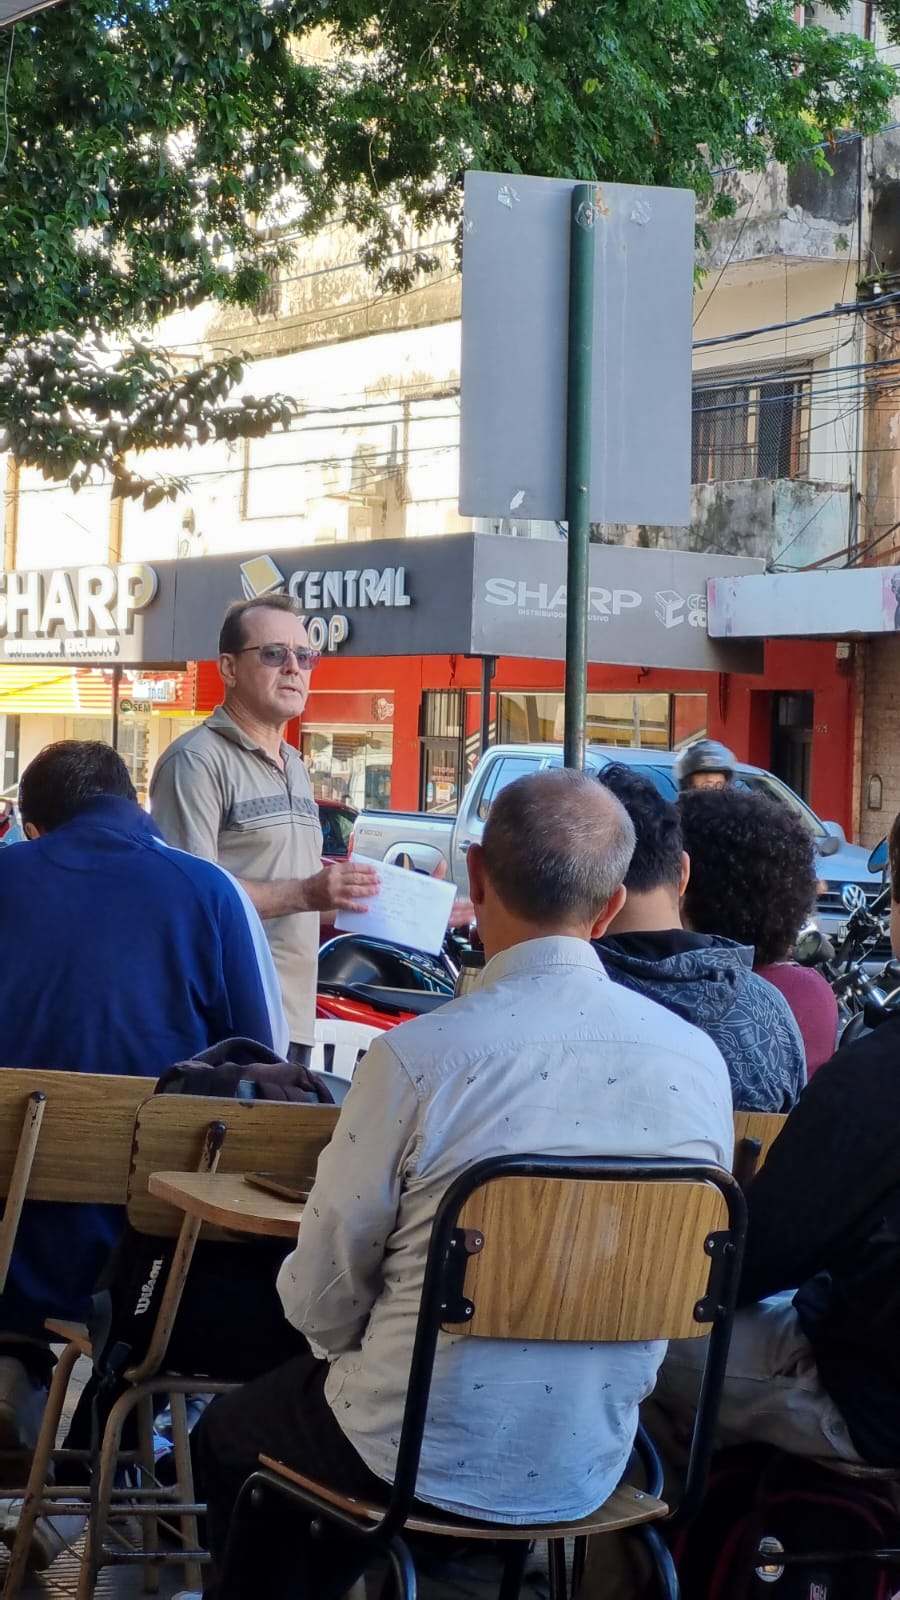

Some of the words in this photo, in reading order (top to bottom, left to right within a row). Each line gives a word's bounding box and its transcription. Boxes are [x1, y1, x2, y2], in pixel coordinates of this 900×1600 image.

[0, 563, 158, 635] HARP
[288, 566, 411, 609] CENTRAL
[297, 615, 349, 652] OP
[134, 1259, 163, 1315] Wilson
